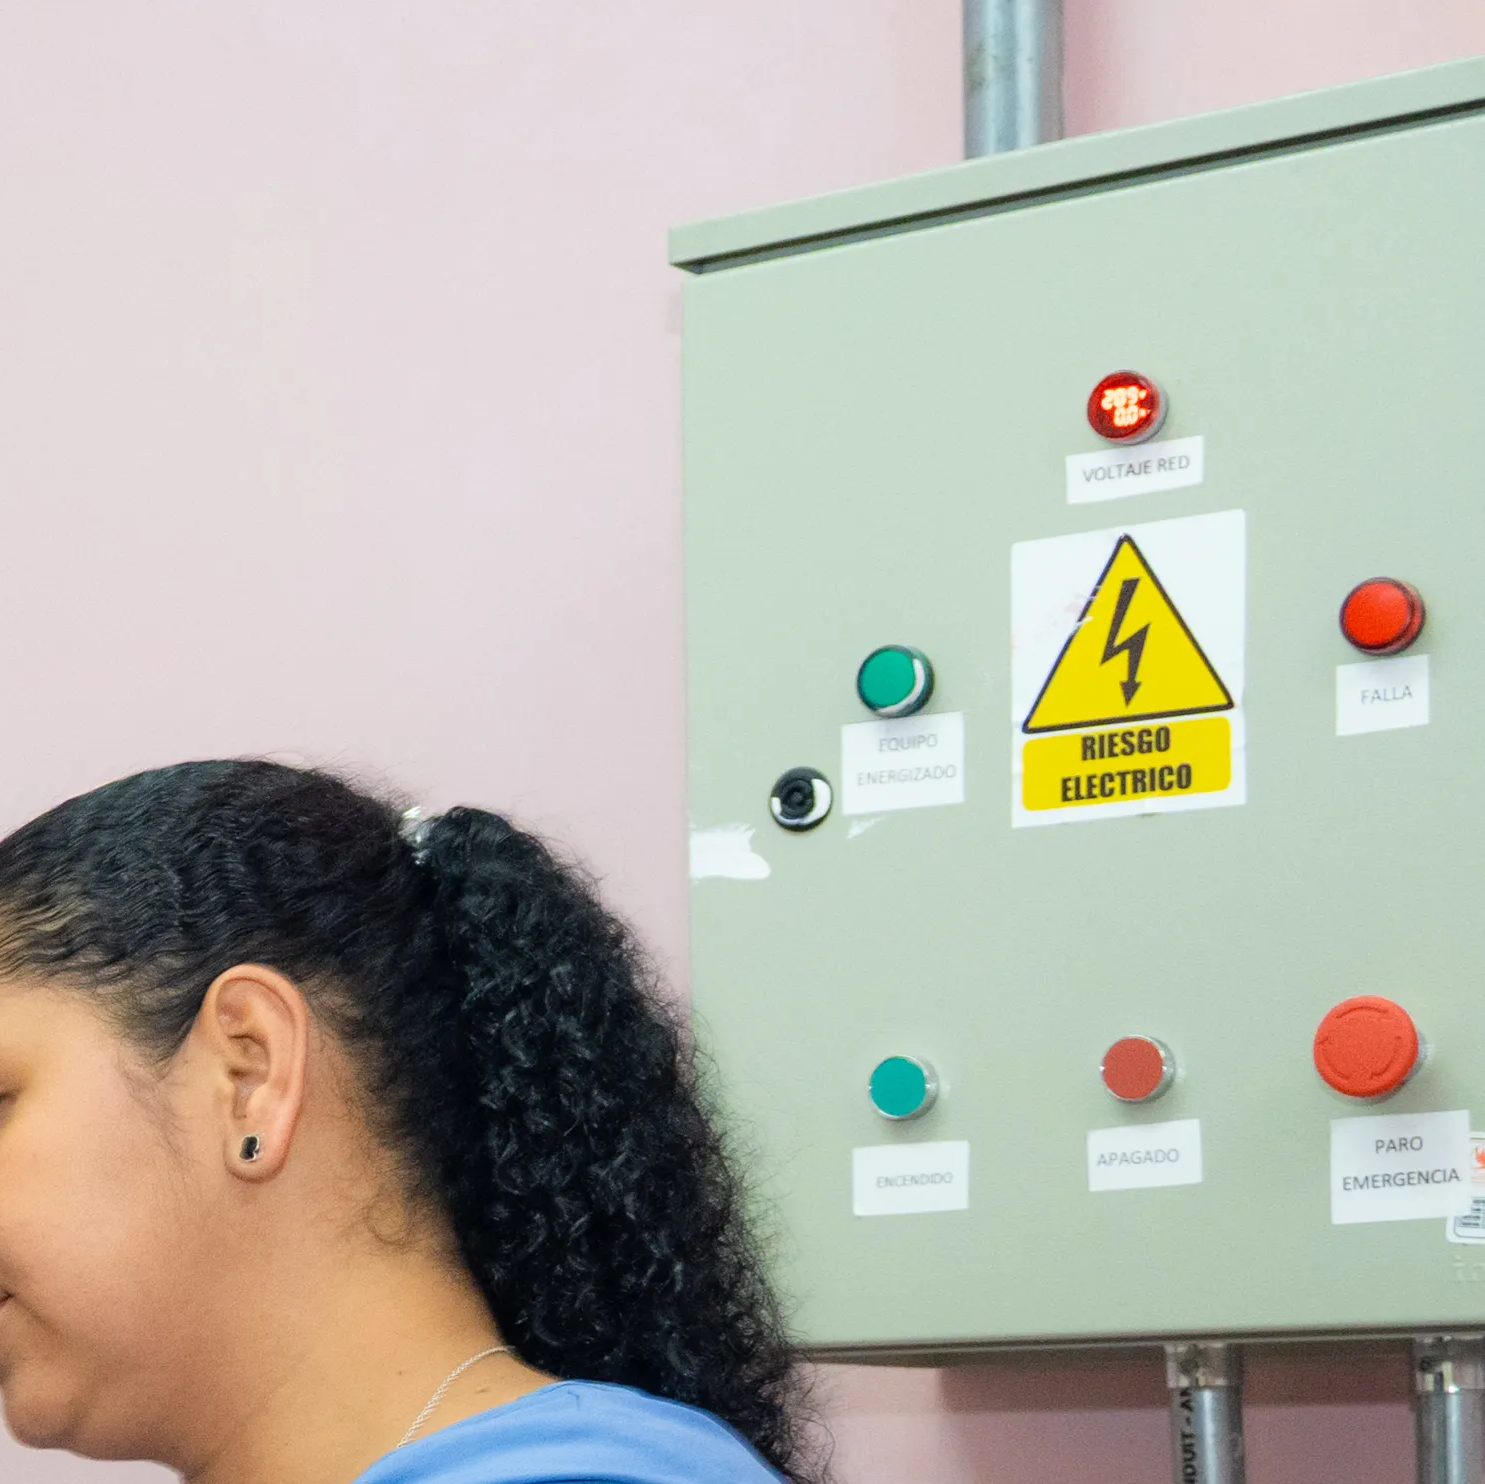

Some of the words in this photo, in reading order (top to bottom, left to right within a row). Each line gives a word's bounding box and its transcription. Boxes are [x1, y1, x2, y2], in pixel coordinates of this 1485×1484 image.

[1082, 460, 1151, 482] VOLTAJE
[1157, 455, 1190, 472] RED
[1361, 685, 1412, 705] FALLA
[878, 734, 938, 752] EQUIPO
[1081, 726, 1171, 761] RIESGO
[857, 765, 957, 786] ENERGIZADO
[1061, 763, 1192, 802] ELECTRICO
[1375, 1136, 1424, 1154] PARO
[1096, 1148, 1179, 1167] APAGADO
[877, 1172, 954, 1188] ENCENDIDO
[1342, 1168, 1460, 1191] EMERGENCIA
